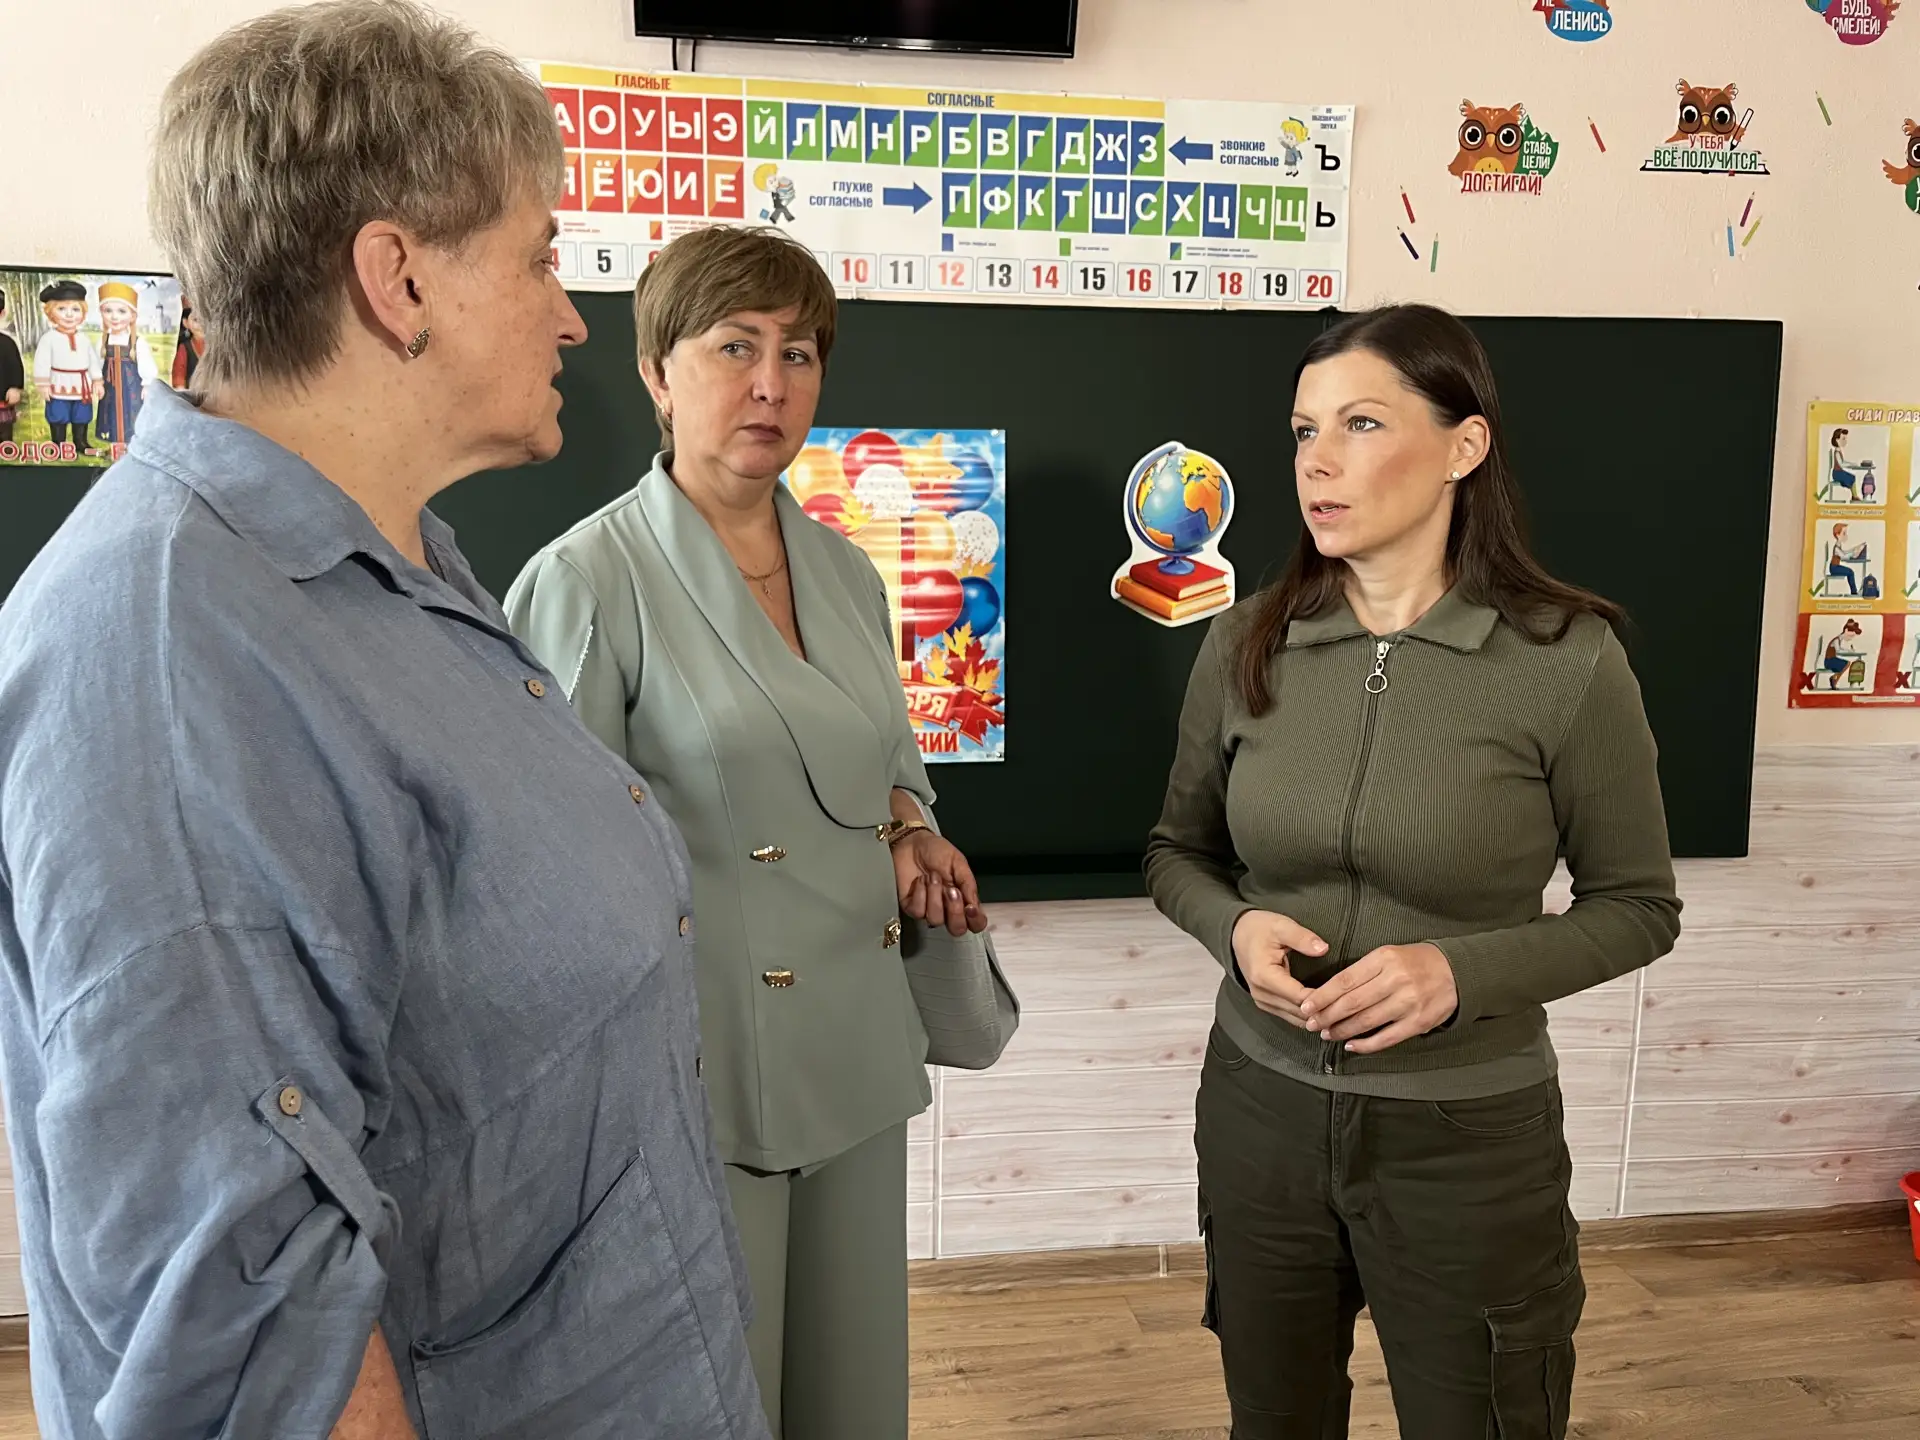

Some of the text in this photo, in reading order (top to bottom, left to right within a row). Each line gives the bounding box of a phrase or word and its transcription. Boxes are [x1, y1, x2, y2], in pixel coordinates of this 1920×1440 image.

[1841, 0, 1872, 17] БУДЬ
[1553, 10, 1609, 32] ЛЕНИСЬ
[1832, 16, 1880, 35] СМЕЛЕЙ!
[615, 74, 672, 90] ГЛАСНЫЕ
[928, 92, 995, 108] СОГЛАСНЫЕ
[554, 103, 575, 133] А
[632, 108, 656, 137] У
[668, 111, 701, 140] Ы
[713, 112, 738, 142] Э
[754, 107, 1158, 166] Й Л М Н Р Б В Г Д Ж З
[1220, 139, 1265, 152] звонкие
[1689, 135, 1724, 150] У ТЕБЯ
[1523, 140, 1552, 155] СТАВЬ
[1220, 153, 1279, 167] согласные
[1314, 144, 1341, 171] Ъ
[1522, 155, 1550, 170] ЦЕЛИ!
[1654, 146, 1757, 170] ВСЁ ПОЛУЧИТСЯ
[593, 160, 616, 197] Ё
[627, 168, 663, 200] Ю
[673, 171, 697, 201] И
[715, 173, 737, 203] Е
[832, 180, 873, 193] глухие
[1461, 171, 1542, 196] ДОСТИГАЙ!
[809, 195, 873, 208] согласные
[949, 185, 1336, 233] П Ф К Т Ш С Х Ц Ч Щ Ь
[597, 249, 612, 274] 5
[841, 258, 868, 283] 10
[889, 260, 914, 285] 11
[938, 261, 965, 286] 12
[985, 263, 1012, 288] 13
[1032, 264, 1059, 289] 14
[1080, 267, 1106, 291] 15
[1126, 268, 1152, 293] 16
[1172, 270, 1199, 293] 17
[1217, 271, 1243, 296] 18
[1262, 273, 1288, 297] 19
[1306, 274, 1333, 298] 20
[1847, 409, 1920, 423] СИДИ ПРАВ
[0, 441, 77, 464] ОДОВ
